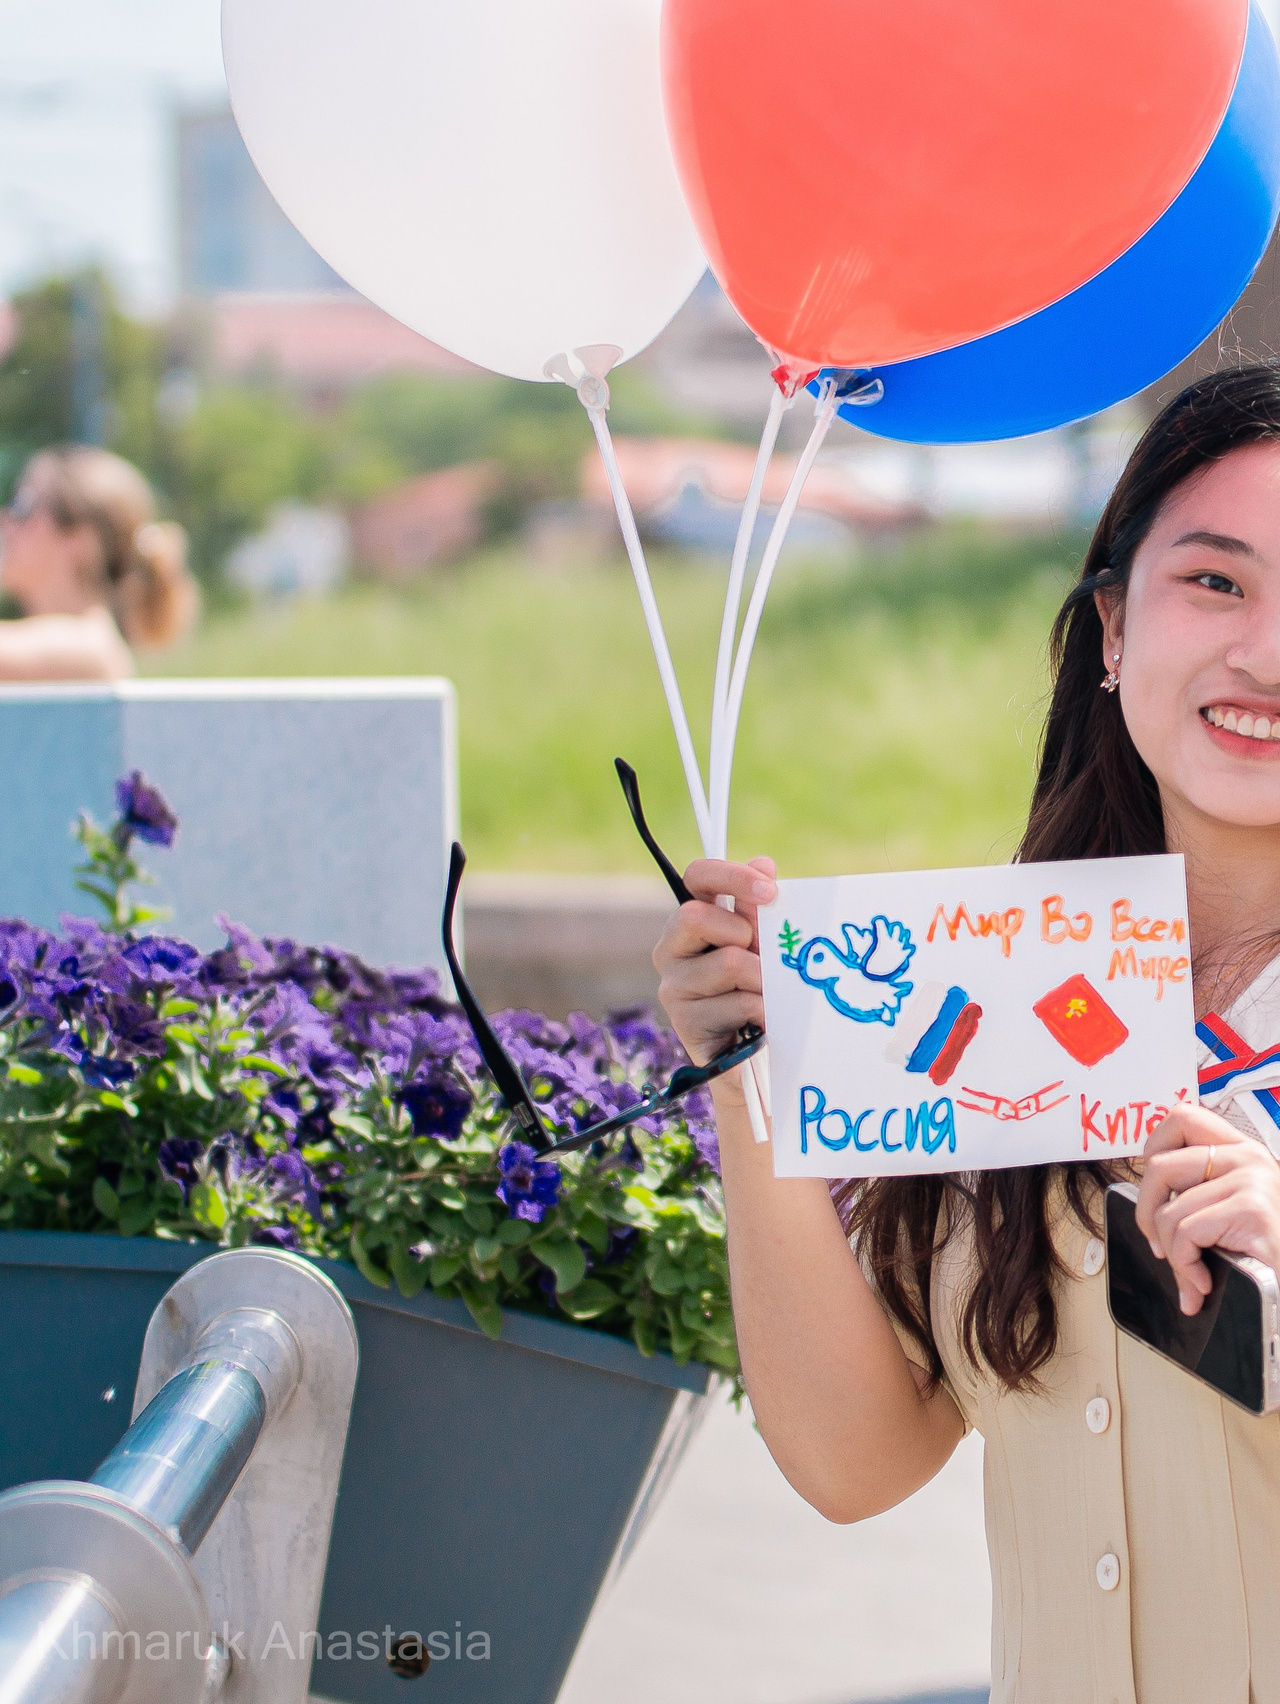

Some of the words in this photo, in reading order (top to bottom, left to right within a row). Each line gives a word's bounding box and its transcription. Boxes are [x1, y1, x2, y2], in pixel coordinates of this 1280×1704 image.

[927, 902, 1026, 957] Мир
[1041, 894, 1093, 944] Во
[1106, 946, 1189, 1001] Мире
[799, 1085, 957, 1154] Россия
